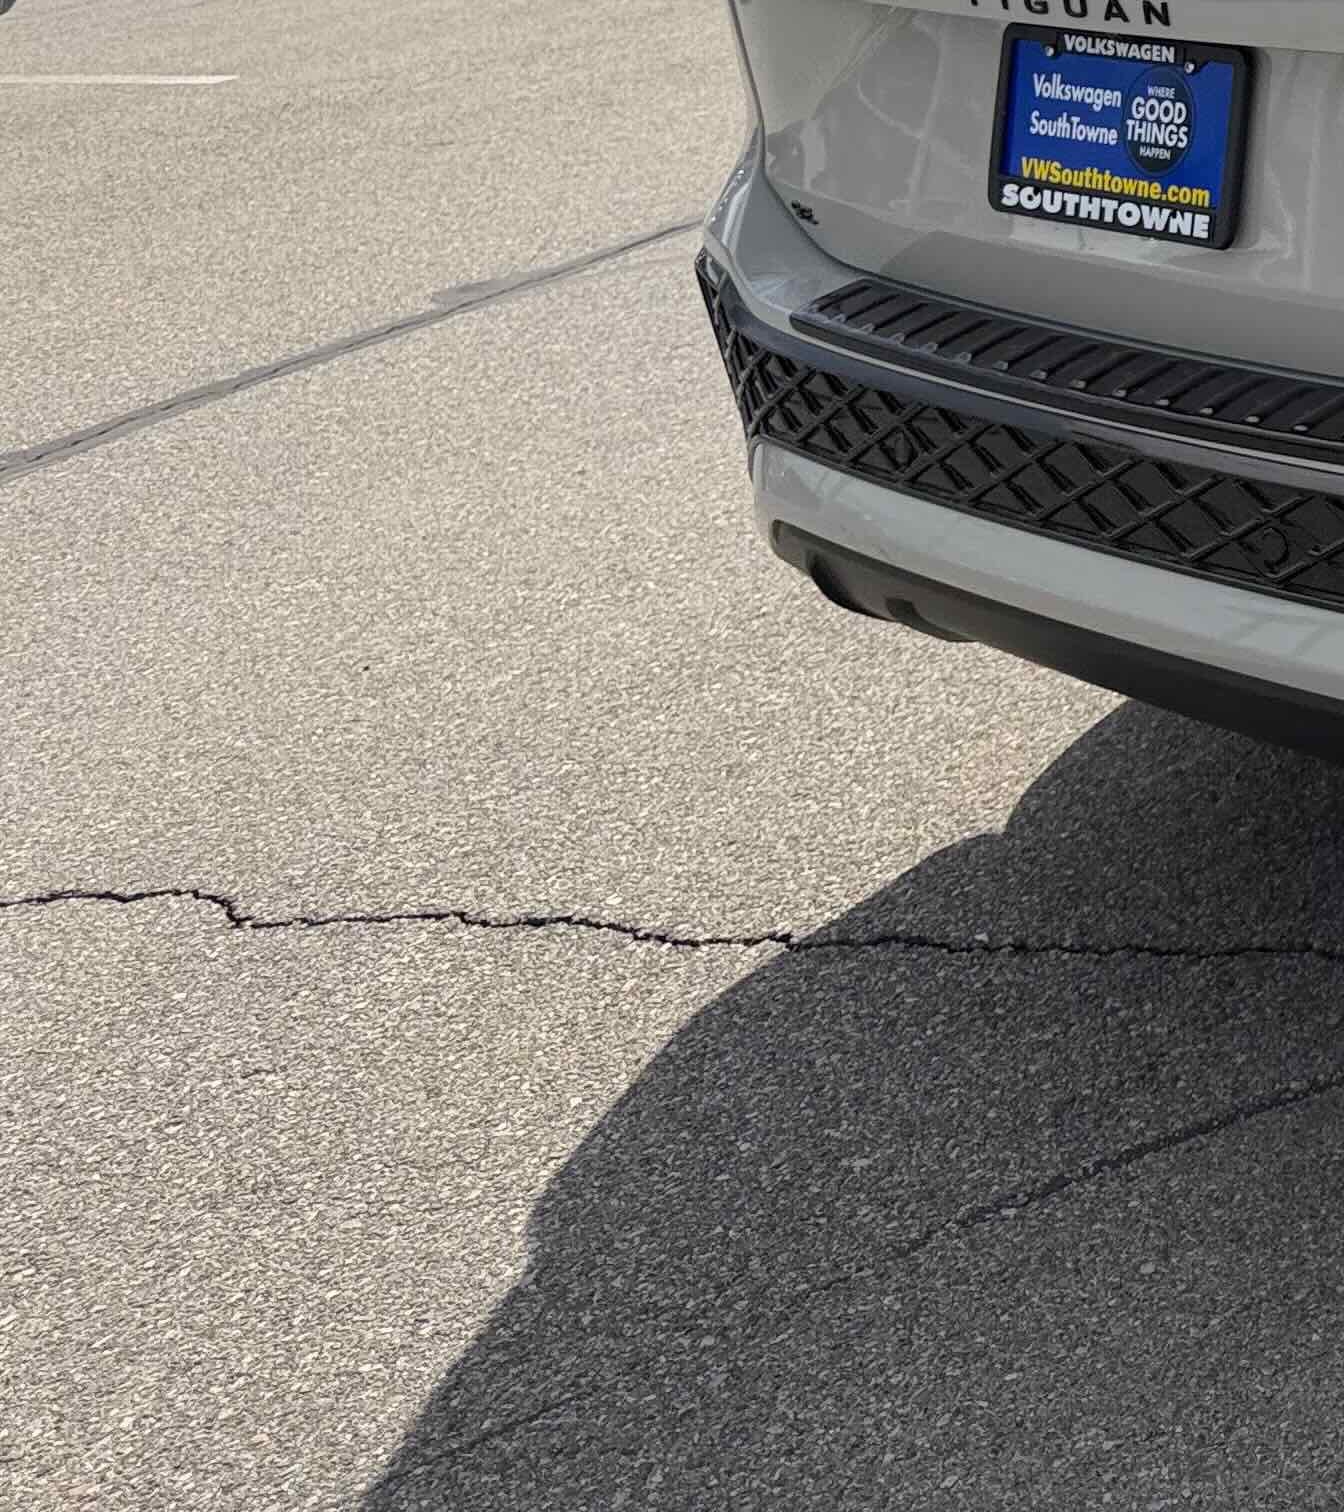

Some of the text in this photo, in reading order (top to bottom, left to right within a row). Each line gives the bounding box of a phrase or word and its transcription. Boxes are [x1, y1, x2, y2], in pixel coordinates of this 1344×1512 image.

[1064, 34, 1175, 63] VOLKSWAGEN
[1033, 72, 1122, 112] Volkswagen
[1147, 85, 1176, 99] WHERE
[1131, 96, 1187, 125] GOOD
[1029, 110, 1119, 146] SouthTowne
[1126, 119, 1189, 149] THINGS
[1139, 146, 1172, 161] HAPPEN
[1021, 156, 1210, 206] VWSouthtowne.com
[1001, 183, 1210, 239] SOUTHTOWNE
